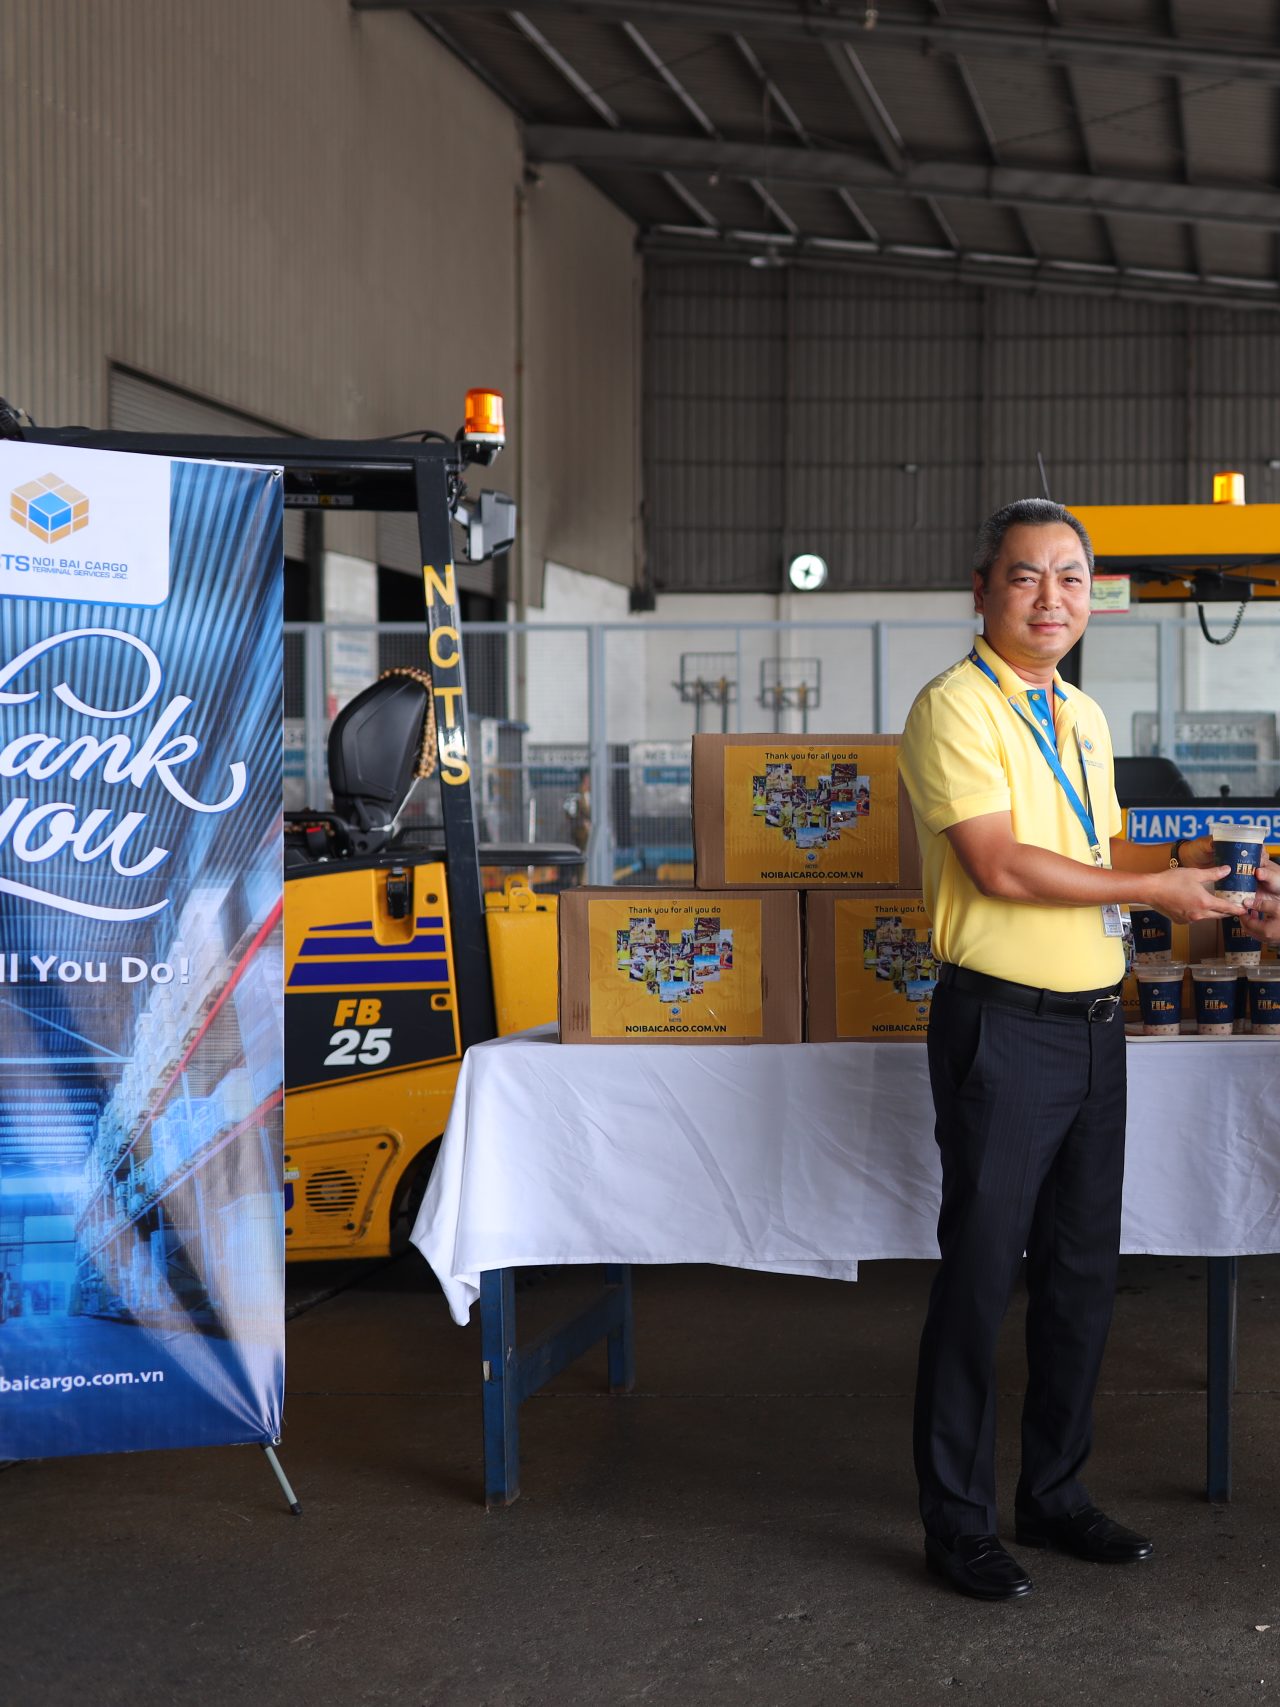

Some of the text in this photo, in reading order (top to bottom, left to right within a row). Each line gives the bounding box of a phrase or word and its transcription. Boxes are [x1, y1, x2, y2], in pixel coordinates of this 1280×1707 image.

[0, 554, 30, 572] TS
[32, 556, 129, 573] NOI BAI CARGO
[32, 566, 71, 576] TERMINAL
[73, 569, 111, 579] SERVICES
[423, 564, 471, 786] NCTS
[0, 627, 248, 813] ank
[765, 752, 858, 761] Thank you for all you do
[760, 871, 864, 879] NOIBAICARGO.COM.VN
[628, 906, 652, 914] Thank
[654, 907, 669, 915] you
[671, 906, 682, 914] for
[683, 906, 693, 914] all
[695, 907, 710, 915] you
[874, 905, 926, 914] Thank you fo
[0, 953, 190, 985] ll You Do!
[333, 998, 383, 1027] FB
[625, 1025, 727, 1033] NOIBAICARGO.COM.VN
[323, 1028, 393, 1066] 25
[0, 1370, 164, 1393] baicargo.com.vn
